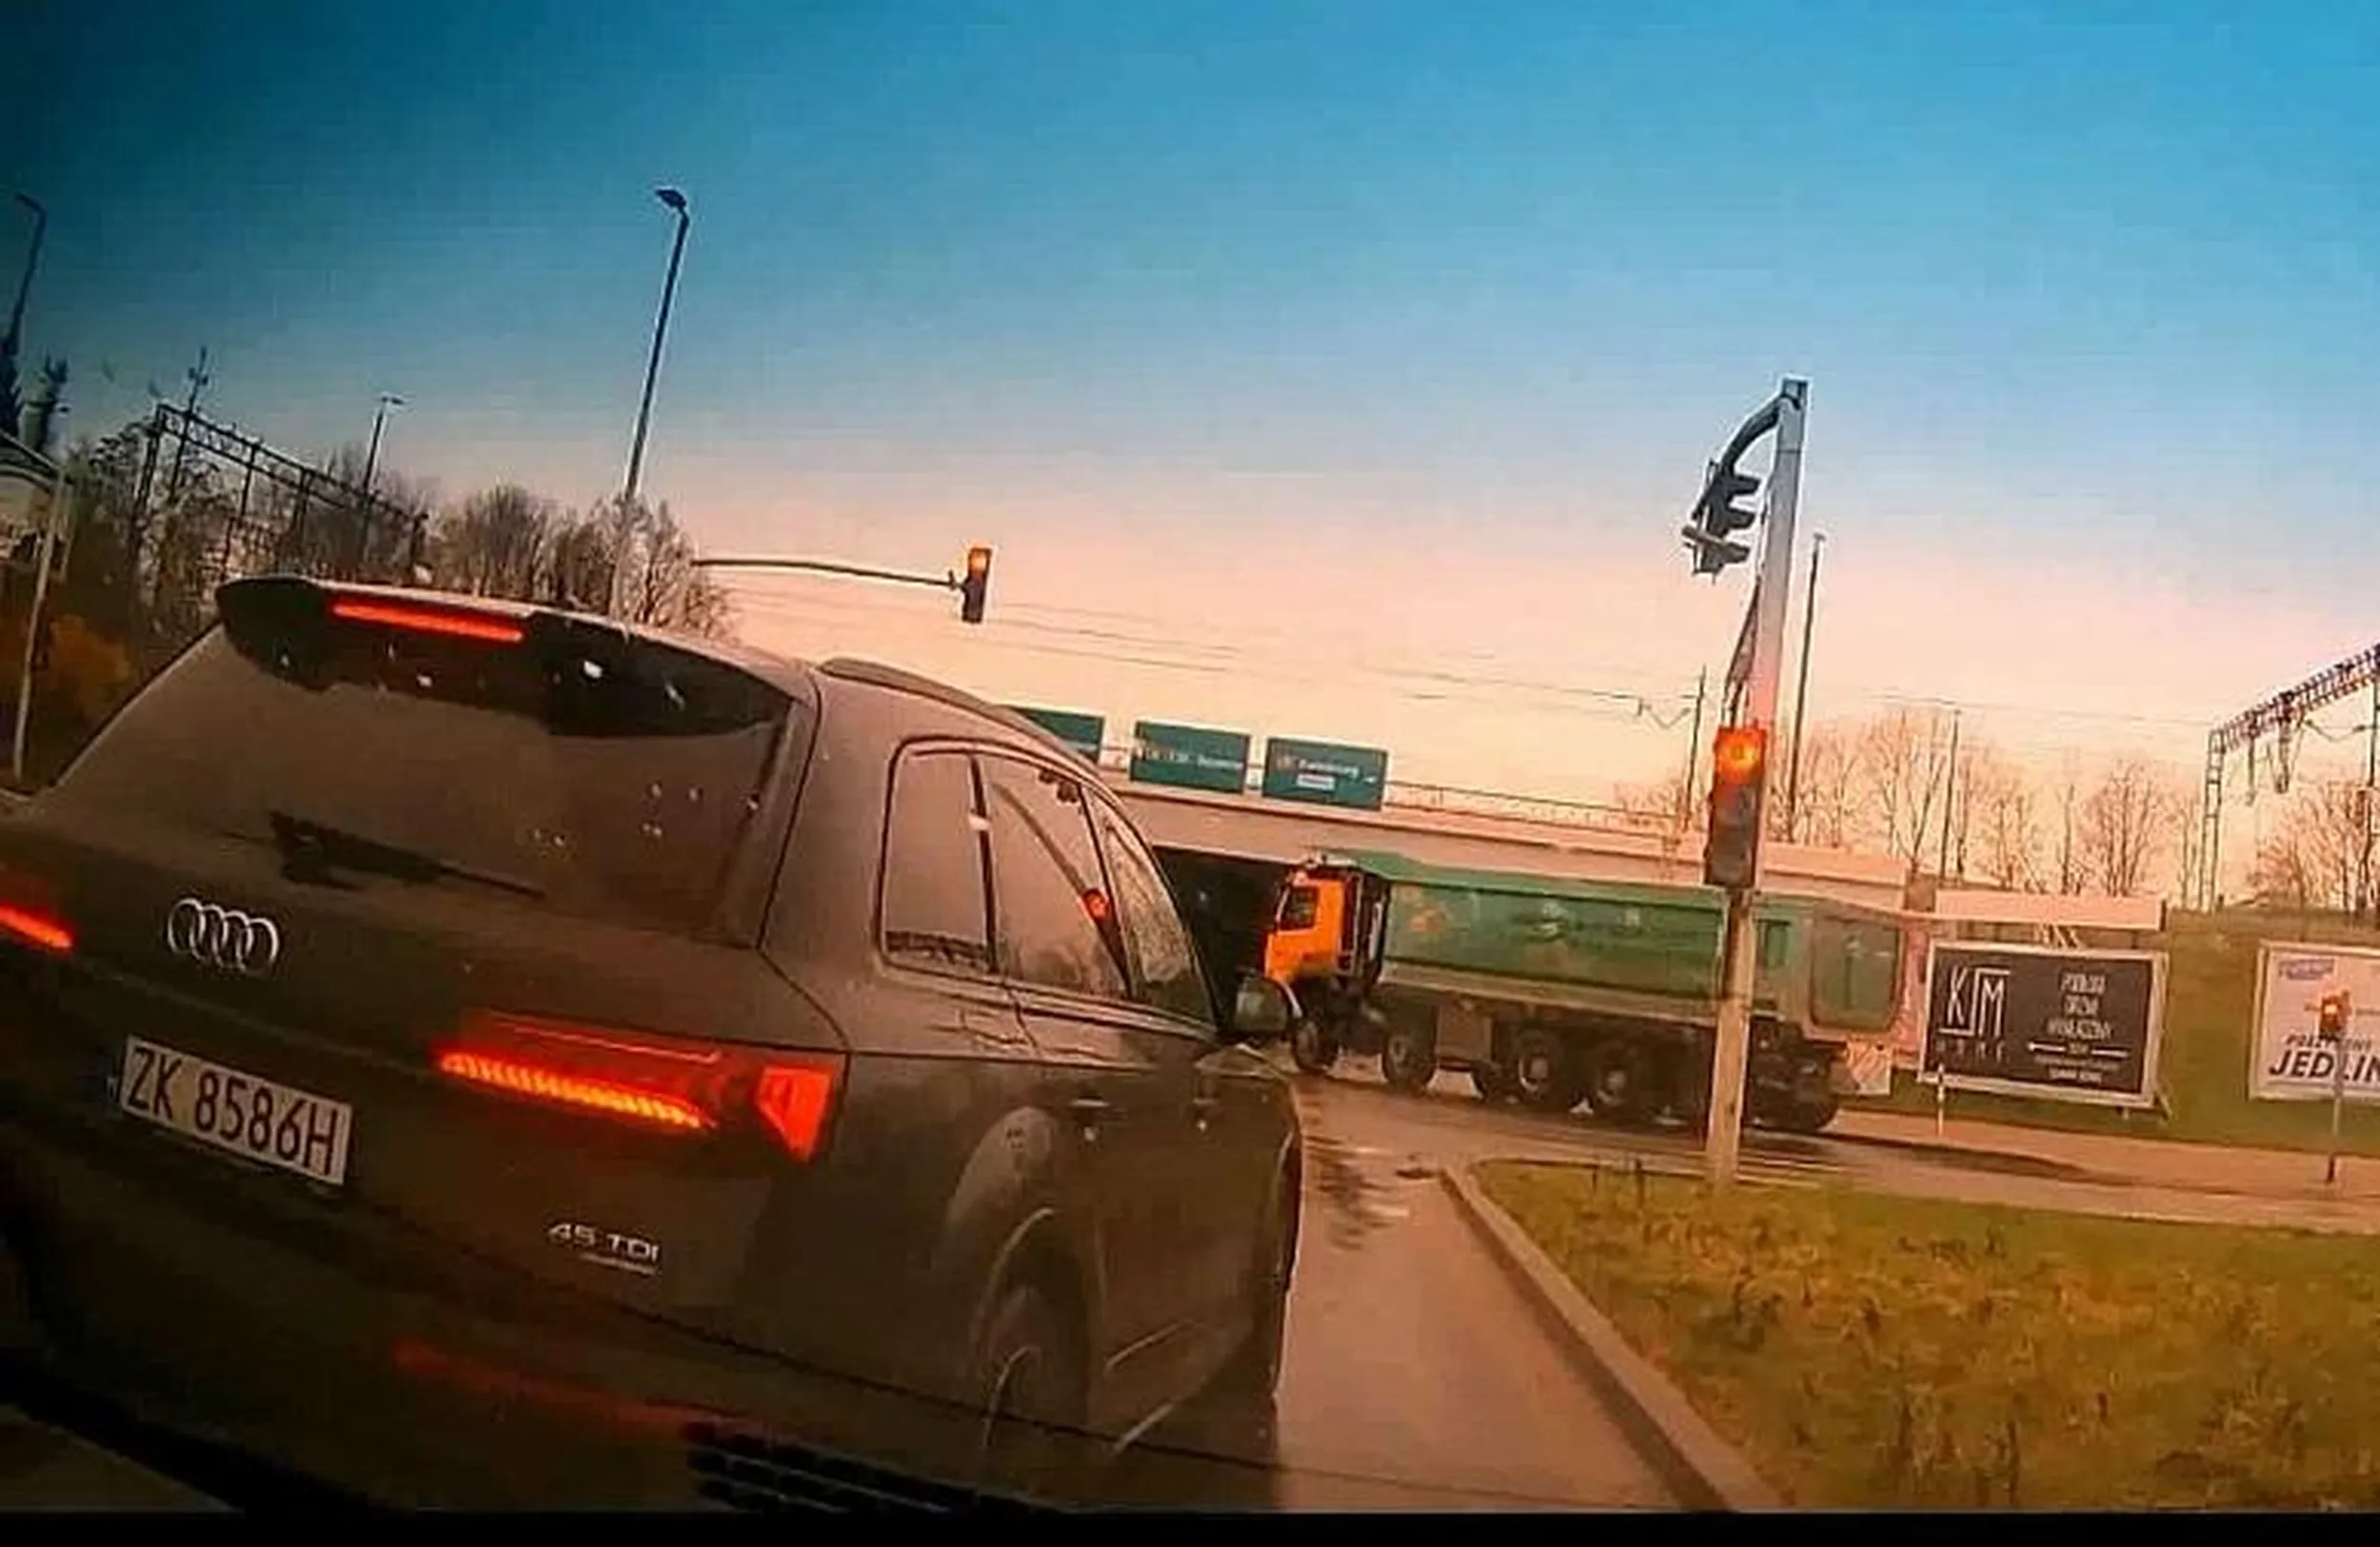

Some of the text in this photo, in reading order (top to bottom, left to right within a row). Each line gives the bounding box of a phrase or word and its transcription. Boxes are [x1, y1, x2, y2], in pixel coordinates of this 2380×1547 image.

[128, 1047, 338, 1176] ZK 8586H
[548, 1222, 659, 1262] 45 TDI
